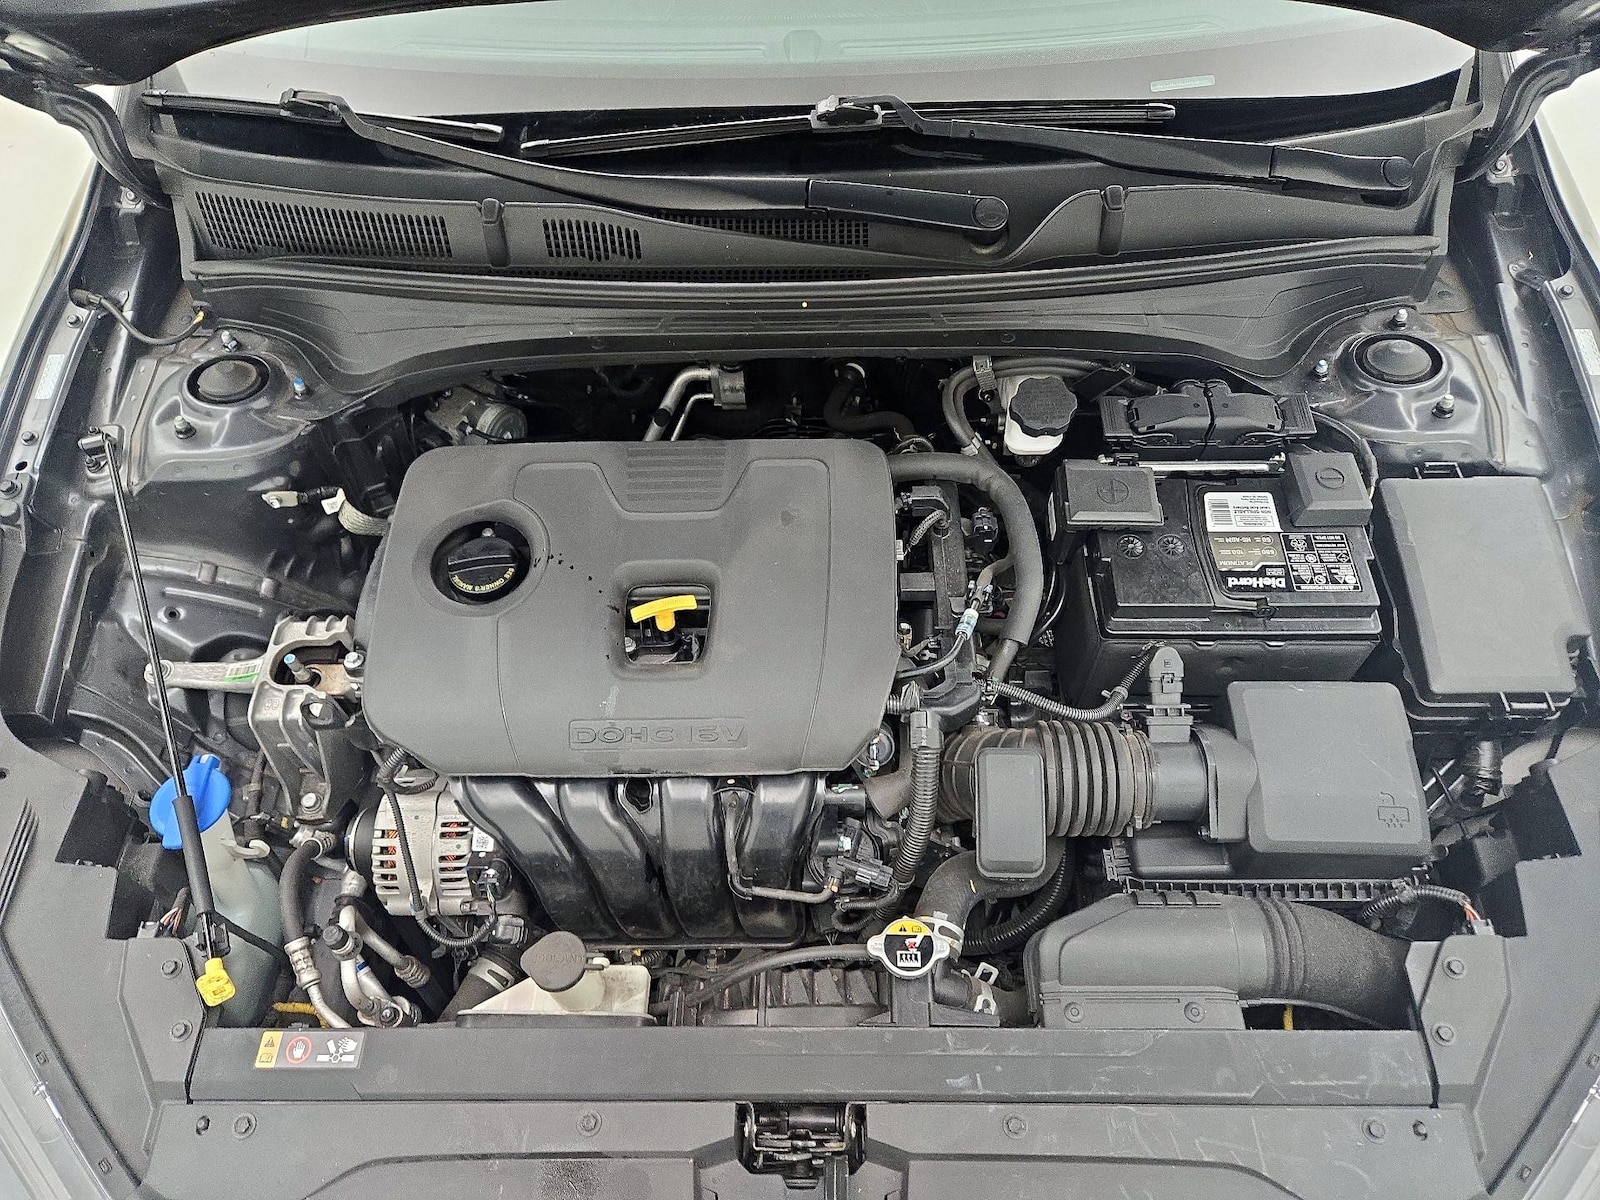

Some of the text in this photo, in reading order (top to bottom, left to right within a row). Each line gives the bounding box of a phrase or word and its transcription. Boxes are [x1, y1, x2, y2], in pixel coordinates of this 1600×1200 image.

[503, 567, 516, 579] SEE
[1227, 577, 1286, 588] DieHard
[574, 726, 674, 744] DOHC
